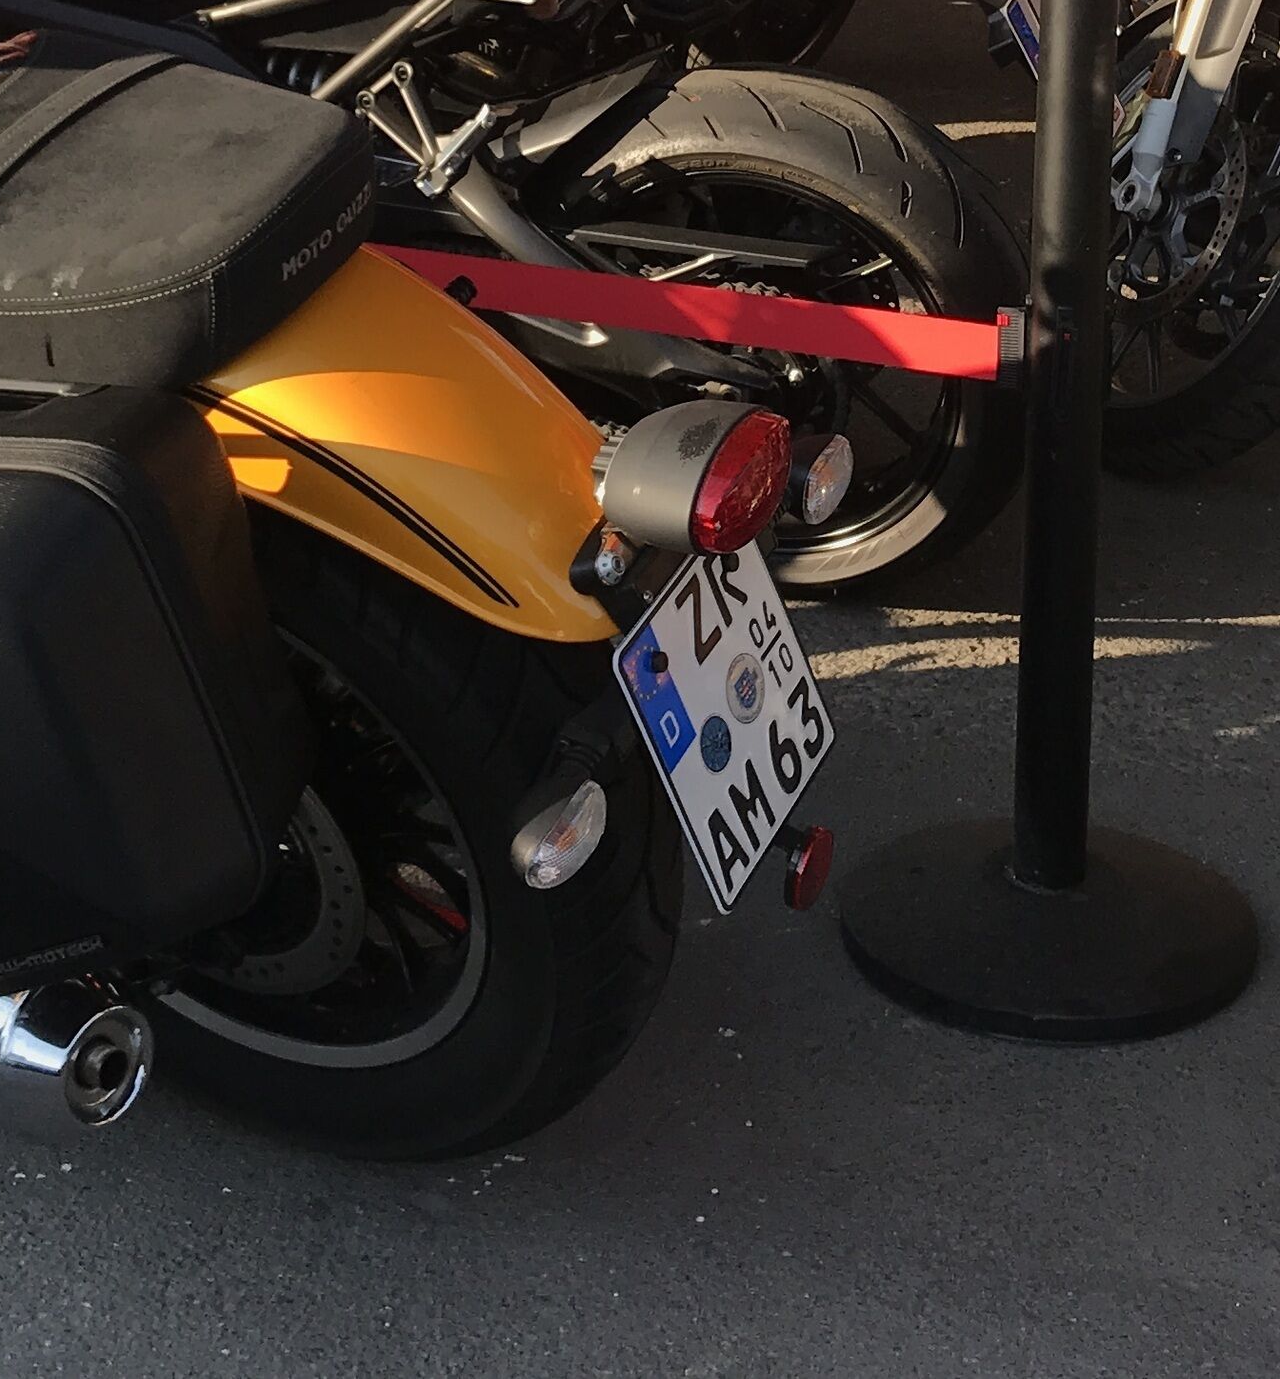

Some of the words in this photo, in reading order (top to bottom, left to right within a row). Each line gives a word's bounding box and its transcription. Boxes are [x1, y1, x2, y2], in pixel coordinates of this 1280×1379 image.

[281, 228, 333, 282] MOTO
[748, 600, 777, 649] 04
[767, 642, 794, 689] 10
[659, 709, 681, 749] D
[705, 757, 777, 894] AM
[768, 675, 826, 796] 63
